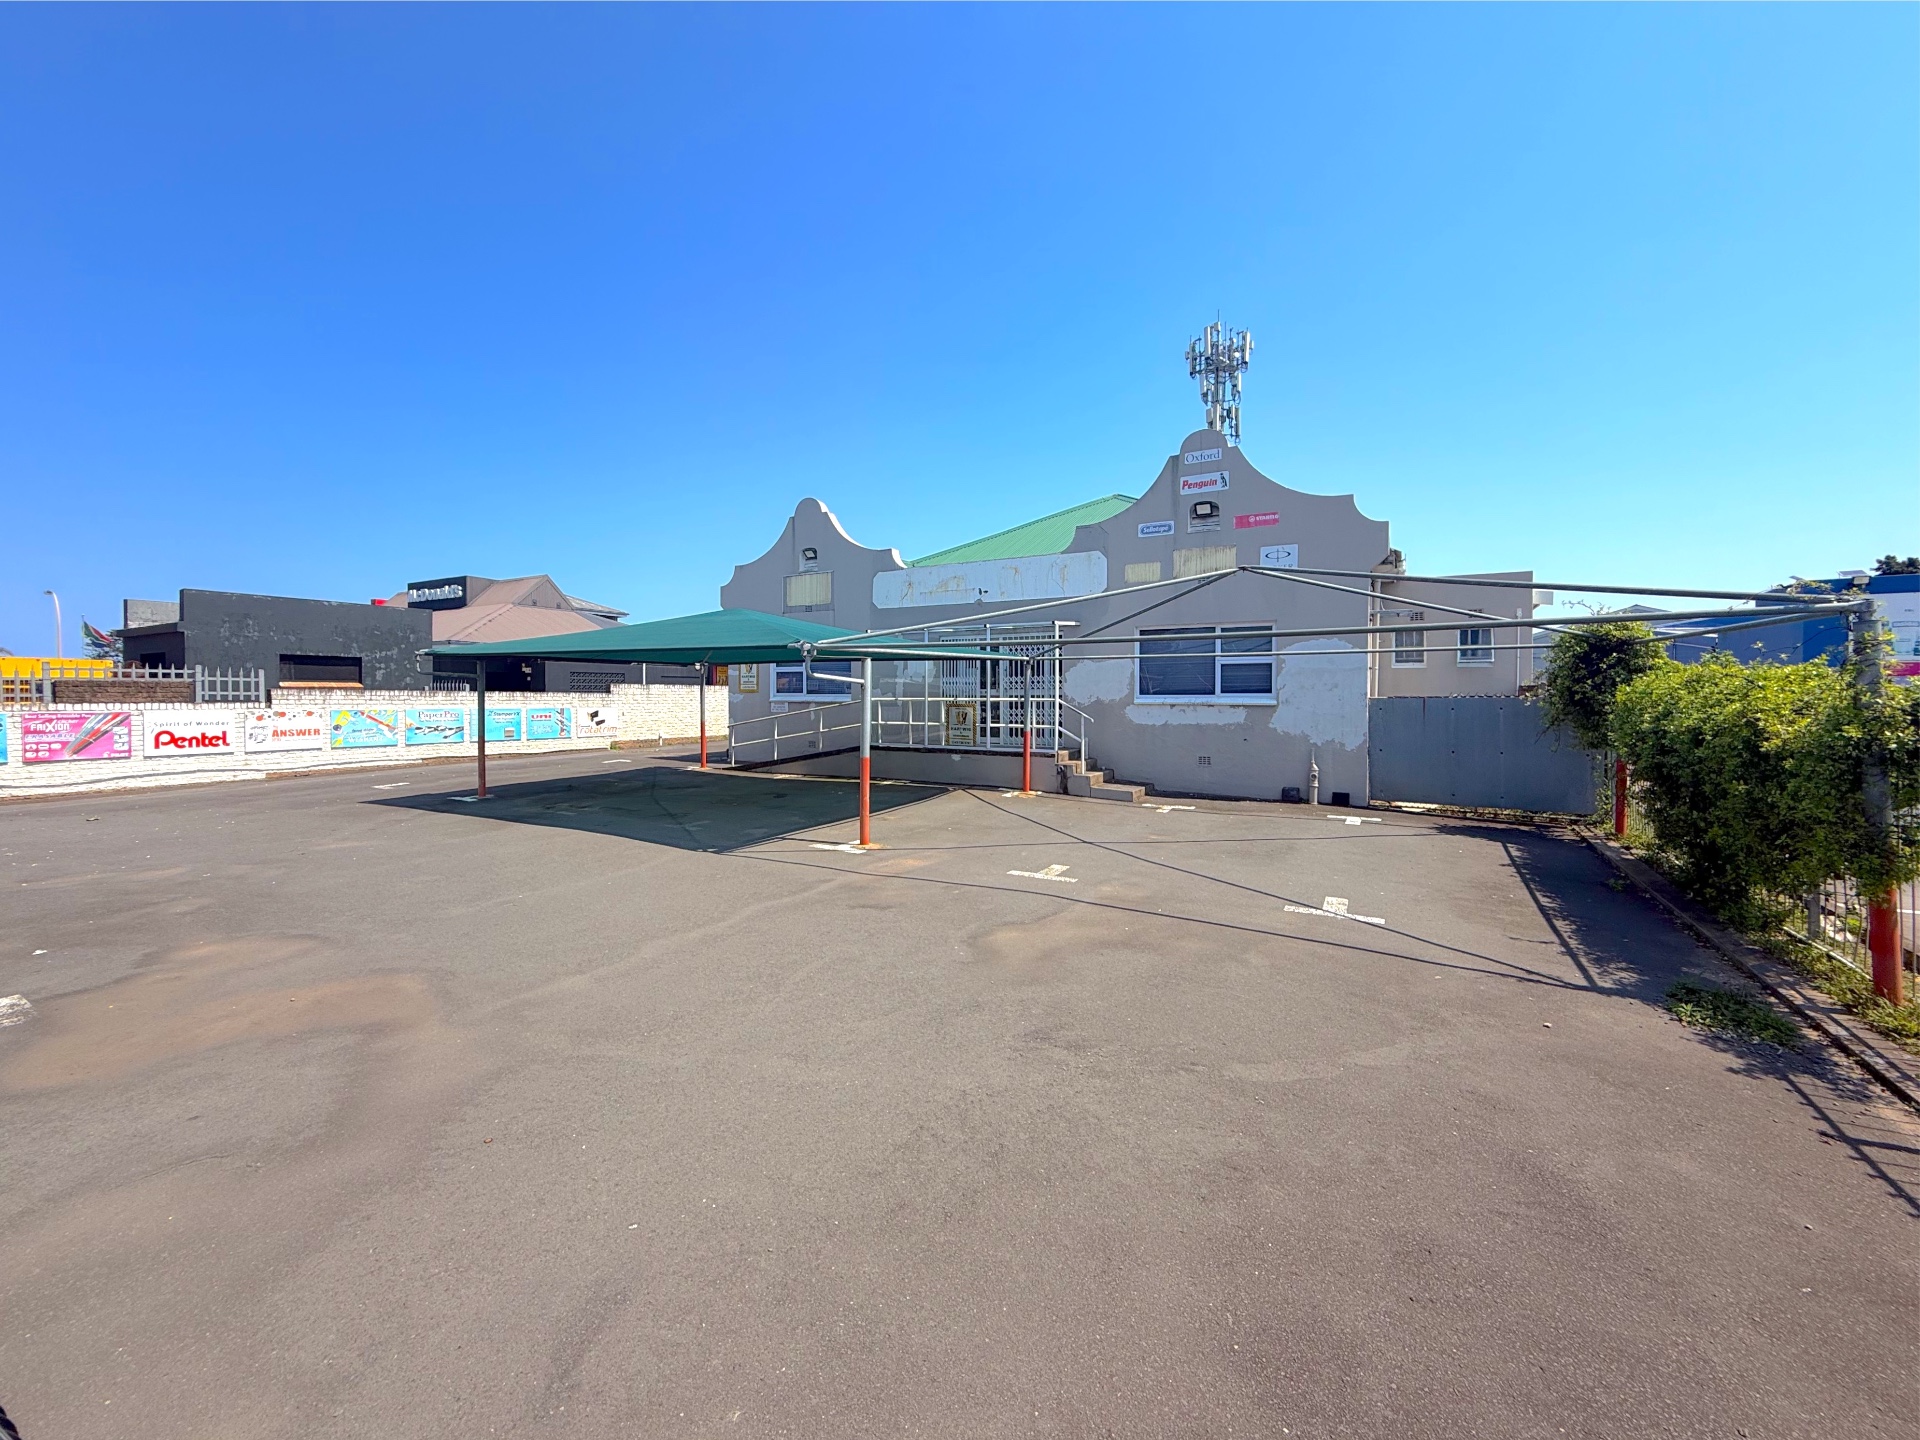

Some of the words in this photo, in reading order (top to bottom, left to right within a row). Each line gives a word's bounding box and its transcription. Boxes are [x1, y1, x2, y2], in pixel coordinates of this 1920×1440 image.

[1185, 449, 1220, 463] Oxford
[1182, 478, 1218, 491] Penguin
[408, 584, 463, 603] McDonald's
[154, 730, 231, 750] Pentel
[271, 728, 321, 738] ANSWER
